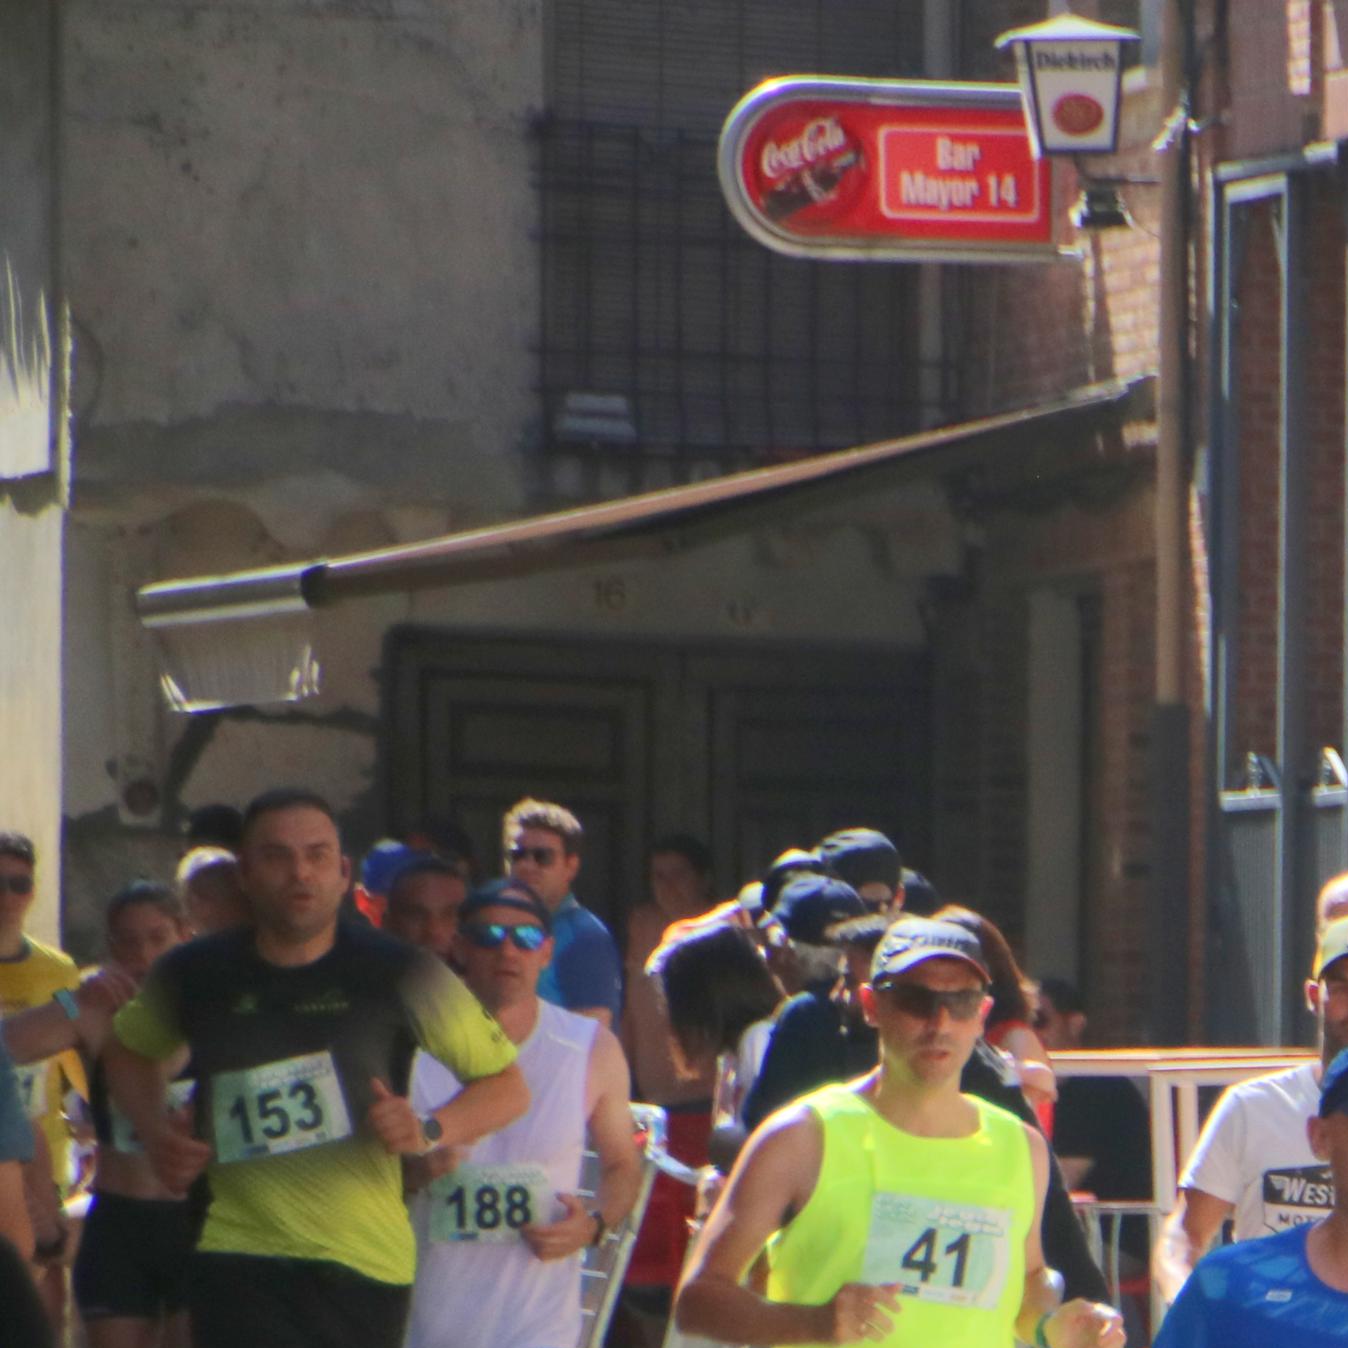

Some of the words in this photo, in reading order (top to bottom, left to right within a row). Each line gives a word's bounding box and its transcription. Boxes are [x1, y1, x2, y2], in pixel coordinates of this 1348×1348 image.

[936, 136, 981, 171] Bar
[900, 170, 980, 211] Mayor
[988, 173, 1018, 207] 14
[229, 1078, 323, 1144] 153
[447, 1184, 531, 1230] 188
[901, 1226, 971, 1287] 41
